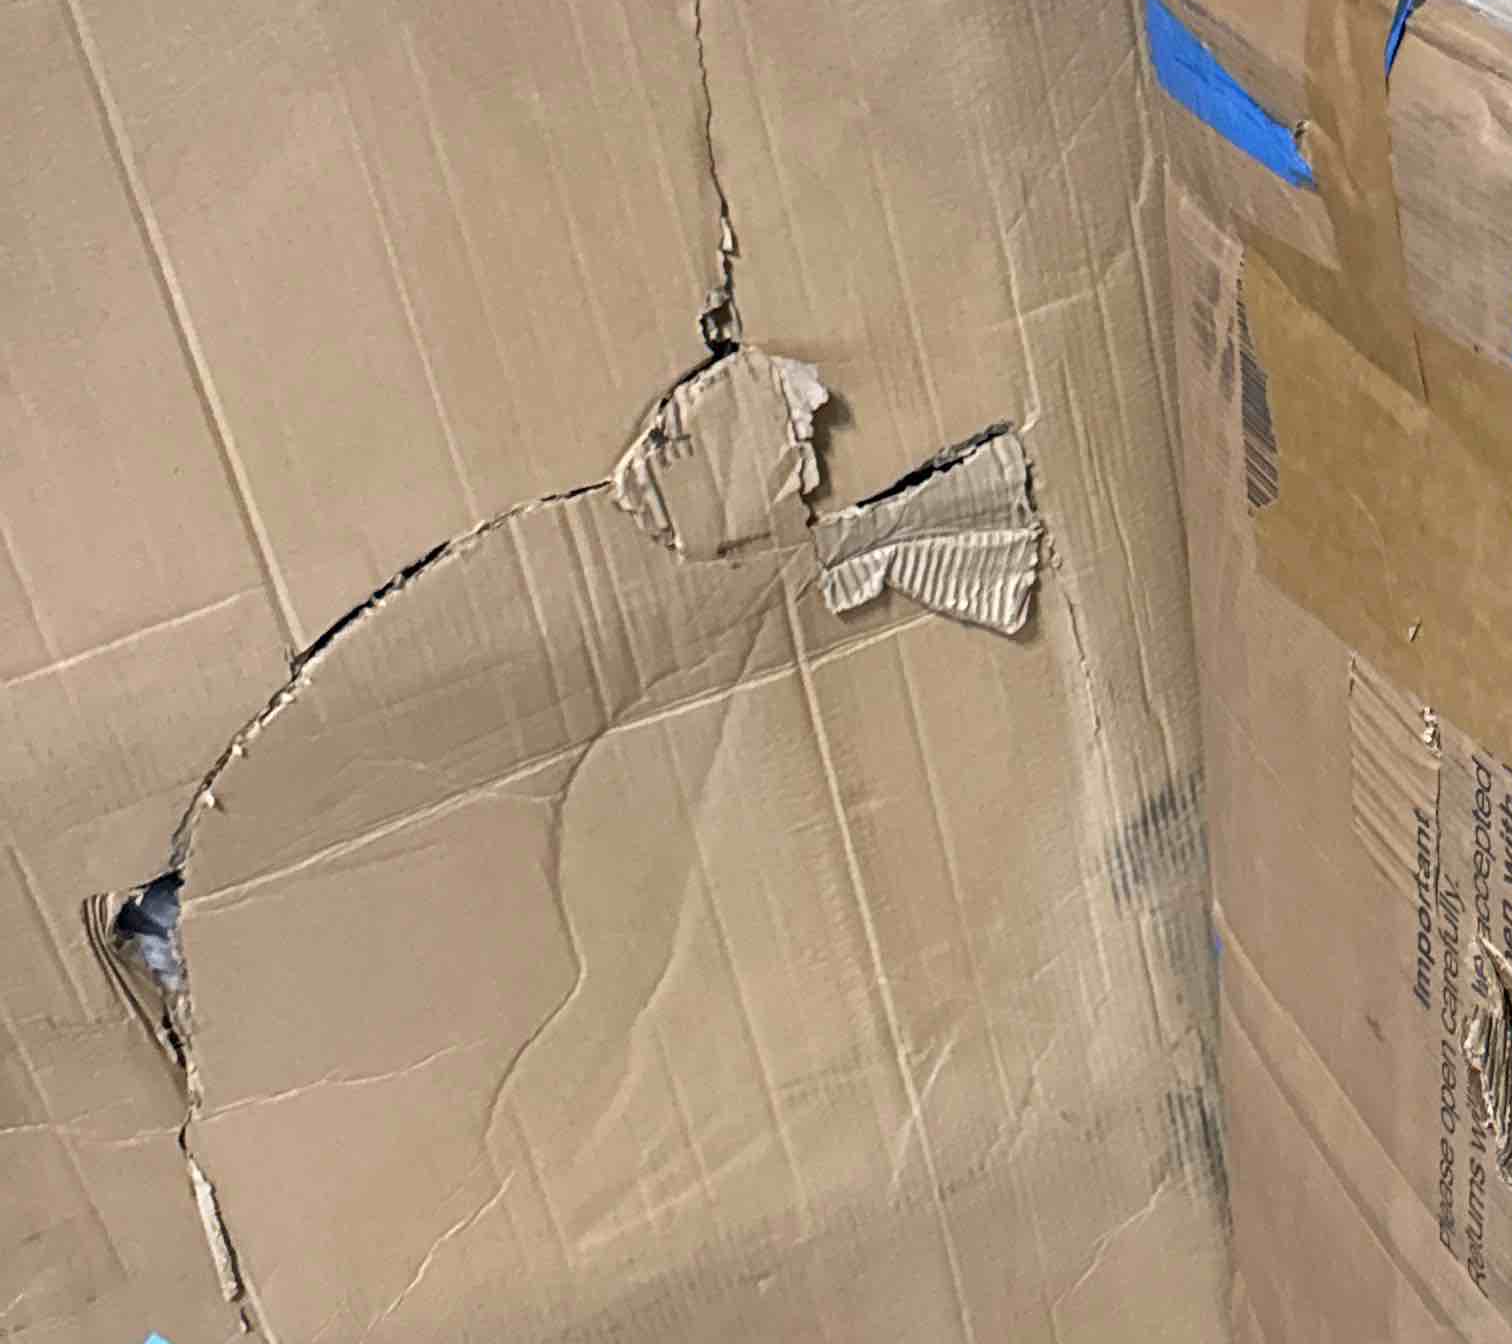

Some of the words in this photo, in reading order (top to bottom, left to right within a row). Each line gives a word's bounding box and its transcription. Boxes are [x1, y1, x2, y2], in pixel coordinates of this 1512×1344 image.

[1413, 807, 1435, 1010] Important
[1440, 1038, 1461, 1136] open
[1439, 1138, 1459, 1263] Please
